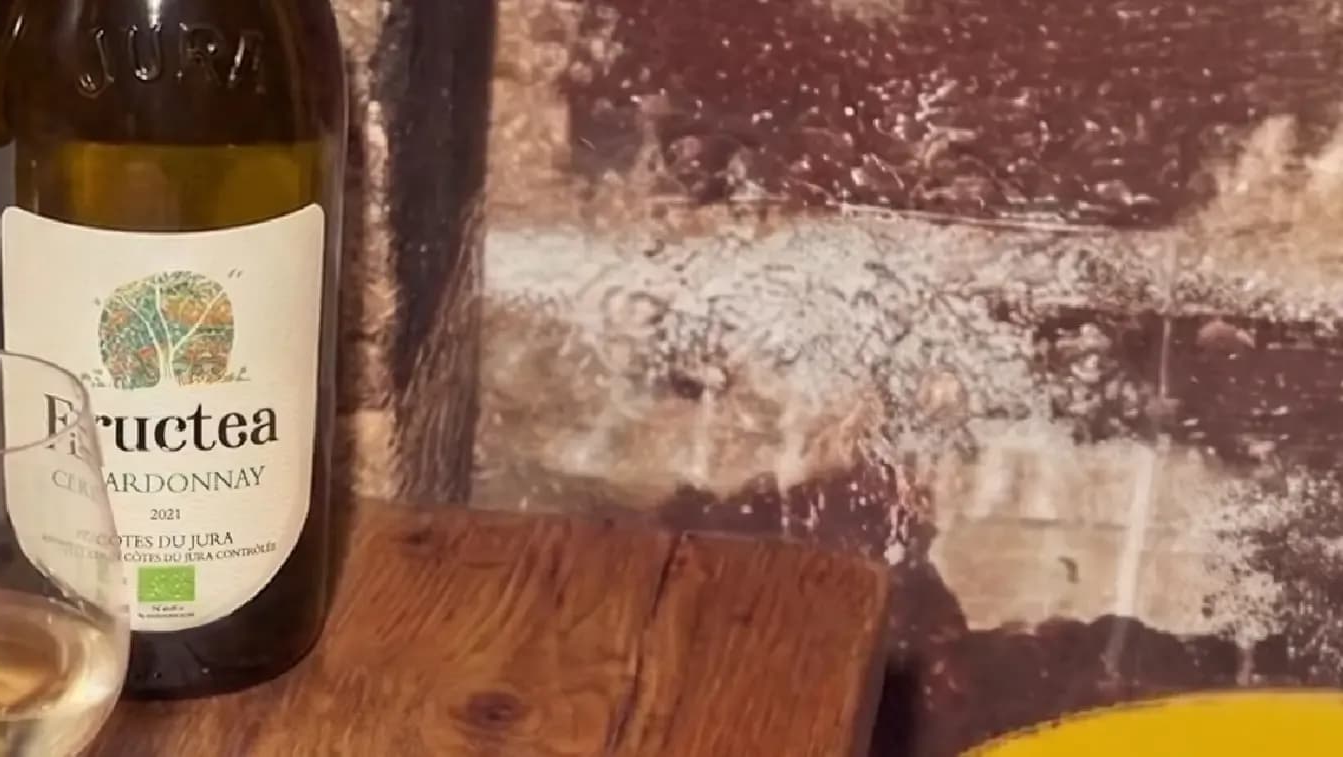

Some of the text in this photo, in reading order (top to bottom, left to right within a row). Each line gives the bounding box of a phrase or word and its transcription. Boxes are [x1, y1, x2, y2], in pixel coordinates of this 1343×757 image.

[77, 24, 265, 97] JURA
[50, 464, 266, 495] CARDONNAY
[150, 508, 181, 521] 2021
[158, 534, 186, 549] DU
[188, 531, 234, 551] JURA
[162, 551, 182, 563] DU
[183, 550, 214, 563] JURA
